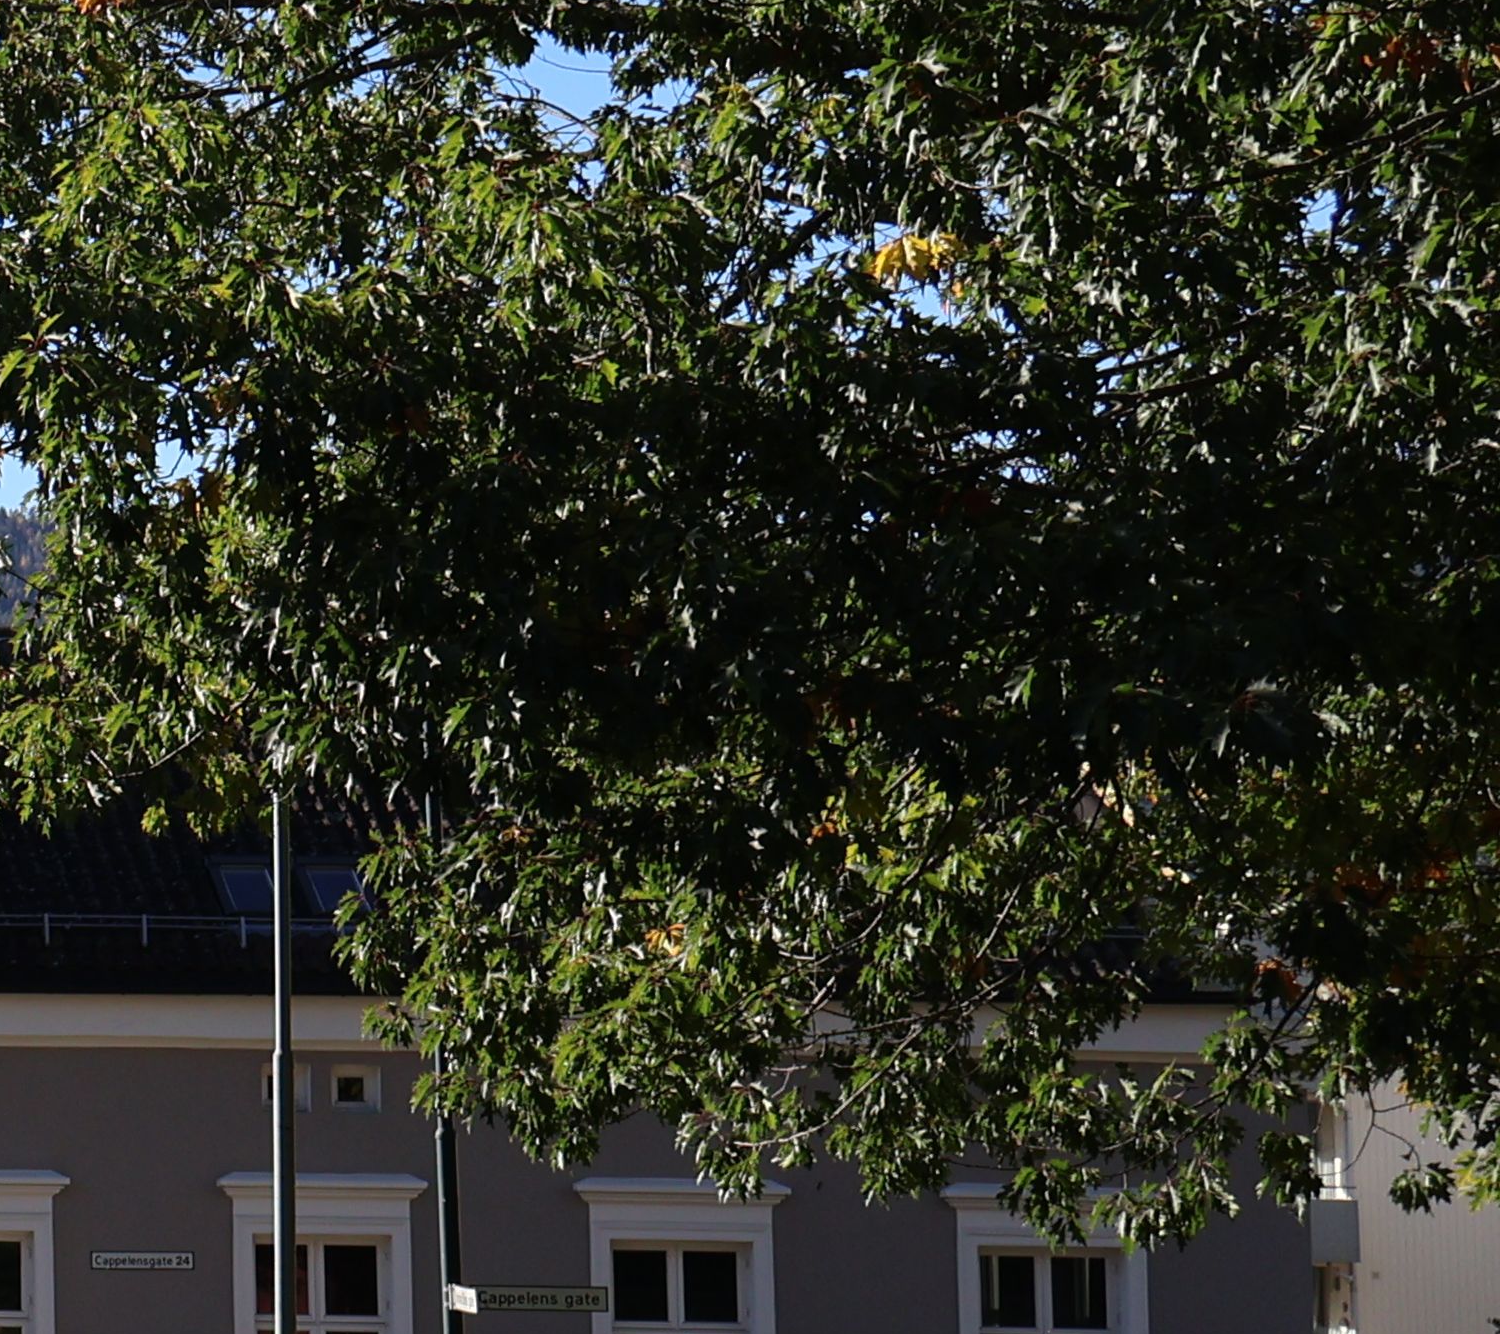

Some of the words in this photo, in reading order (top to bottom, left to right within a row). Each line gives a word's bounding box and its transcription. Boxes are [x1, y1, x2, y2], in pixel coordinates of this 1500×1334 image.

[175, 1255, 190, 1266] 24
[478, 1290, 559, 1307] Cappelens
[564, 1293, 600, 1308] gate
